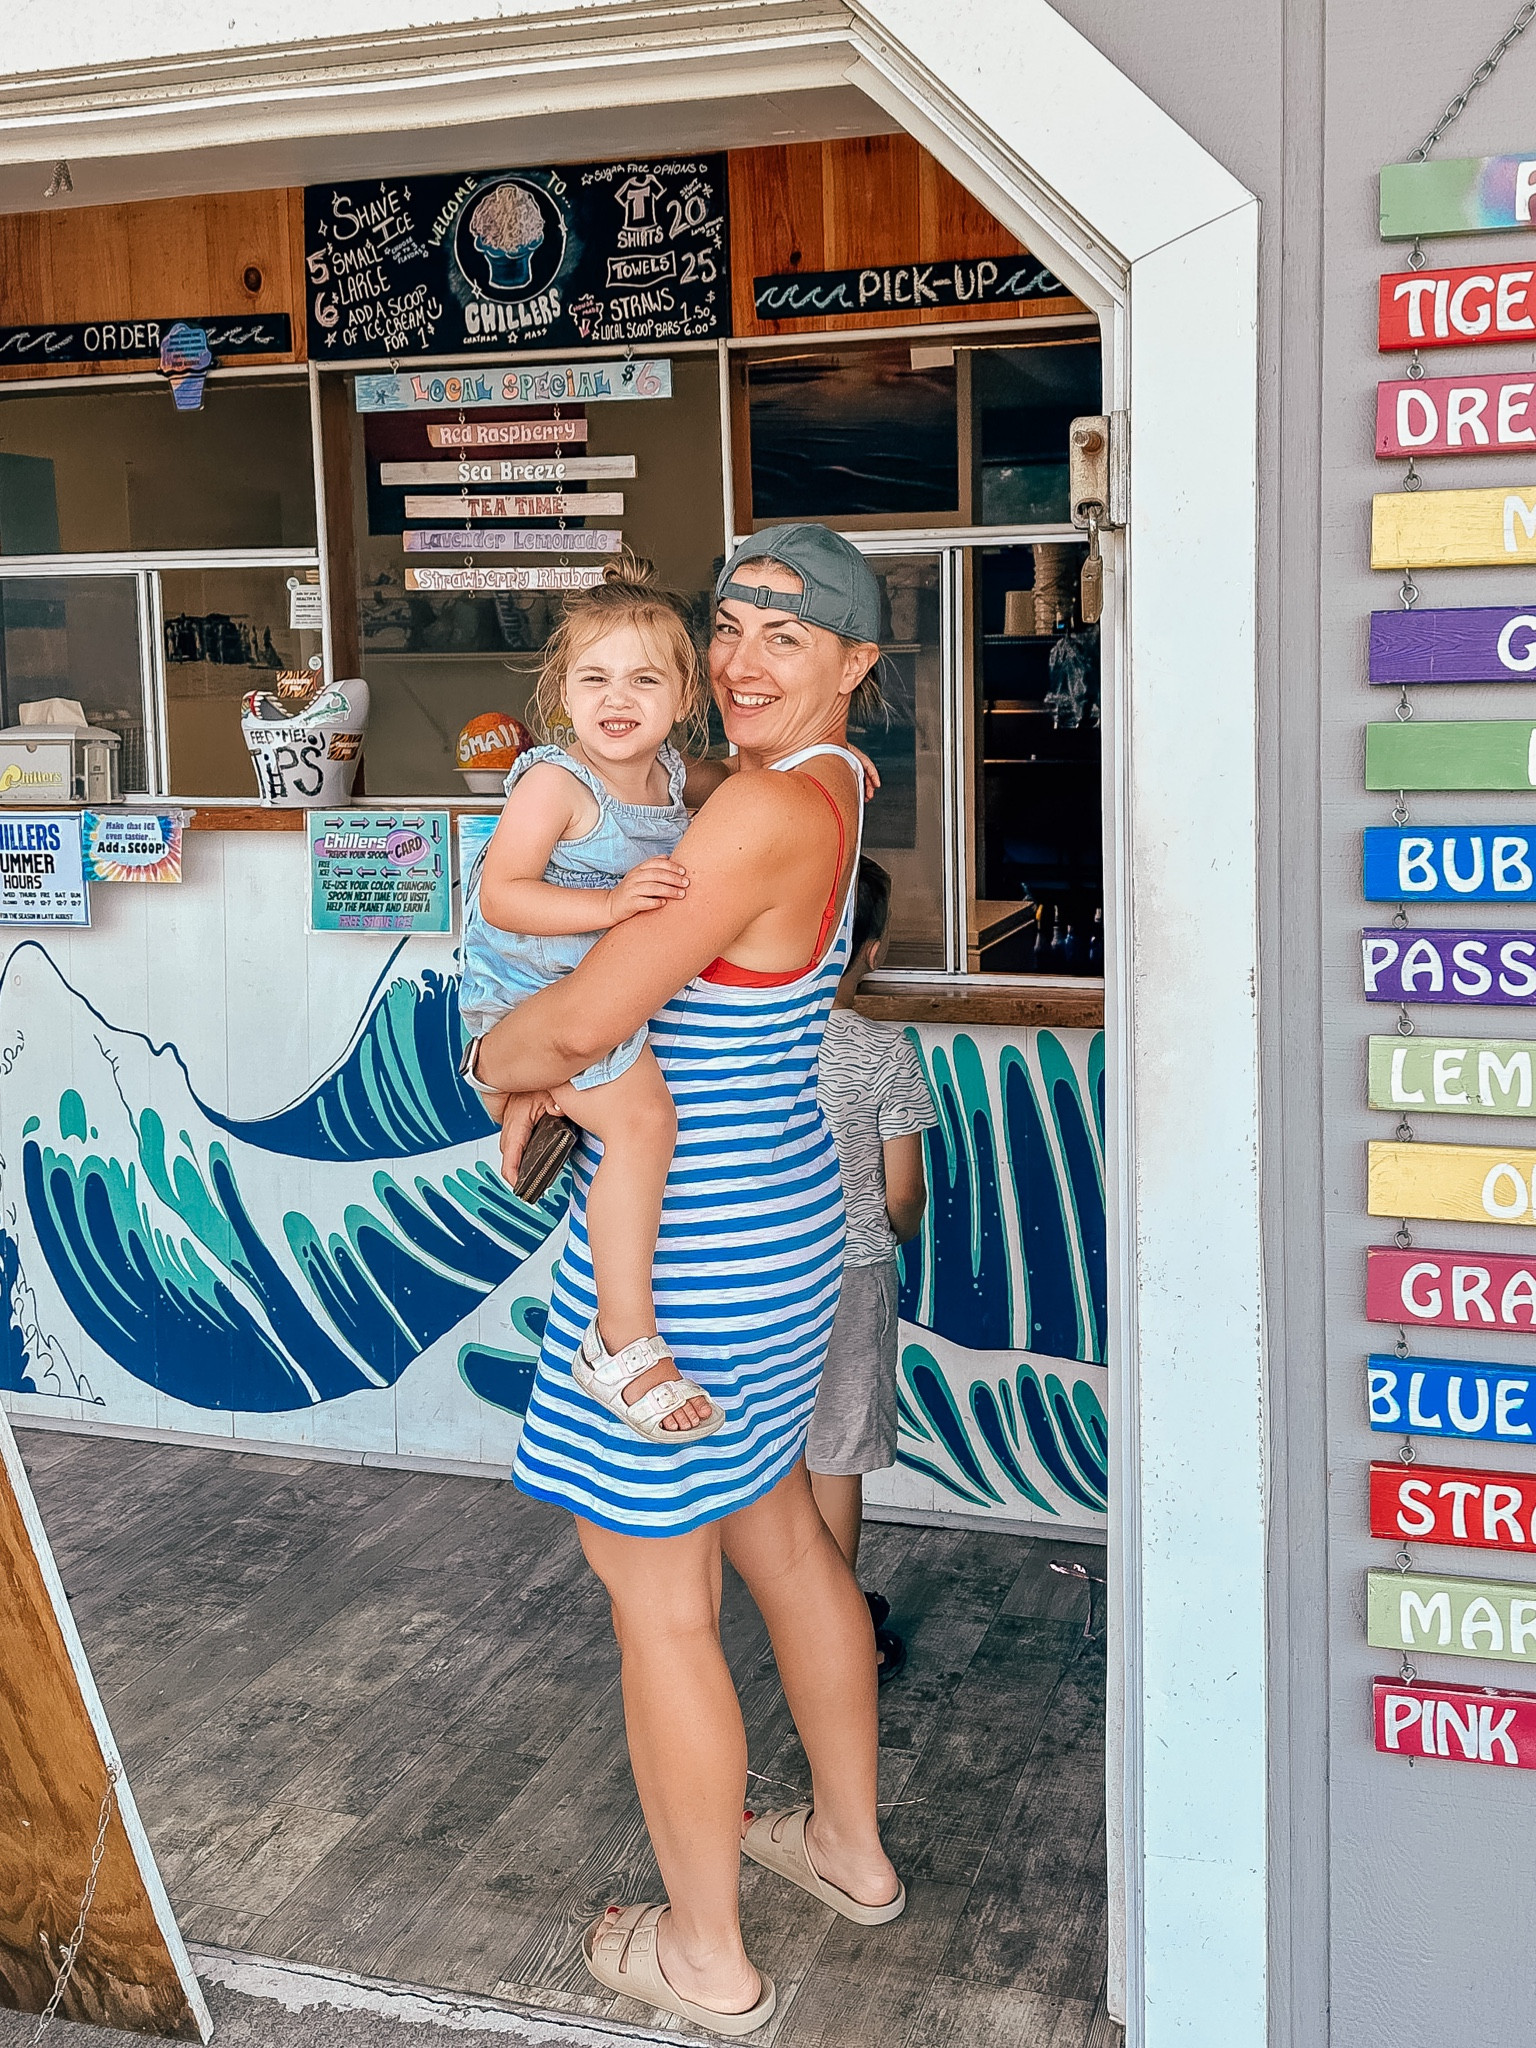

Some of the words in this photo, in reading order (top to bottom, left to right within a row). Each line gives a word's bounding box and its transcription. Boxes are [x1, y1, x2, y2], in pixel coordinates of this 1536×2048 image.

[333, 190, 401, 241] SHAVE
[428, 176, 478, 247] WELCOME
[372, 212, 415, 249] ICE
[617, 226, 664, 249] SHIRTS
[332, 245, 384, 276] SMALL
[392, 251, 402, 261] UP
[402, 246, 411, 254] TO
[410, 242, 418, 251] 3
[612, 256, 670, 280] TOWELS
[338, 266, 391, 305] LARGE
[859, 261, 998, 306] PICK-UP
[348, 305, 373, 327] ADD
[376, 301, 387, 319] A
[387, 284, 427, 316] SCOOP
[464, 287, 562, 334] CHILLERS
[573, 299, 594, 312] HOUSE
[610, 287, 675, 321] STRAWS
[84, 323, 160, 351] ORDER
[343, 326, 358, 346] OF
[363, 318, 385, 341] ICE
[385, 305, 426, 336] CREAM
[463, 334, 498, 344] CHATHAM
[524, 327, 548, 340] MASS
[600, 324, 625, 341] LOCAL
[627, 319, 654, 339] SCOOP
[654, 321, 681, 338] BARS
[384, 331, 409, 353] FOR
[410, 374, 494, 402] LOCAL
[1396, 383, 1536, 447] DRE
[440, 426, 472, 444] Red
[477, 420, 576, 445] Raspberry
[458, 463, 492, 482] Sea
[500, 462, 566, 481] Breeze
[420, 531, 506, 550] Lavender
[513, 531, 608, 550] Lemonade
[419, 568, 530, 591] Strawberry
[536, 570, 606, 588] Rhubar
[250, 730, 274, 745] FEED
[105, 822, 124, 830] Make
[127, 822, 142, 830] that
[144, 822, 156, 830] ICE
[105, 833, 123, 841] even
[97, 841, 120, 854] Add
[121, 845, 126, 854] a
[127, 841, 166, 855] SCOOP!
[324, 832, 388, 849] Chillers
[395, 836, 423, 858] CARD
[349, 850, 366, 859] YOUR
[317, 860, 331, 868] FREE
[1398, 836, 1533, 893] BUB
[4, 875, 43, 890] HOURS
[322, 880, 348, 890] RE-USE
[350, 881, 369, 890] YOUR
[370, 881, 395, 890] COLOR
[396, 881, 437, 891] CHANGING
[326, 902, 344, 912] HELP
[344, 902, 357, 912] THE
[358, 902, 385, 912] PLANET
[385, 902, 401, 912] AND
[402, 902, 423, 912] EARN
[424, 902, 431, 912] A
[327, 891, 353, 901] SPOON
[354, 891, 373, 901] NEXT
[373, 892, 393, 901] TIME
[393, 892, 409, 901] YOU
[338, 915, 361, 927] FREE
[1362, 937, 1536, 997] PASS
[1391, 1048, 1533, 1108] LEM
[1368, 1367, 1533, 1436] BLUE
[1384, 1694, 1519, 1765] PINK
